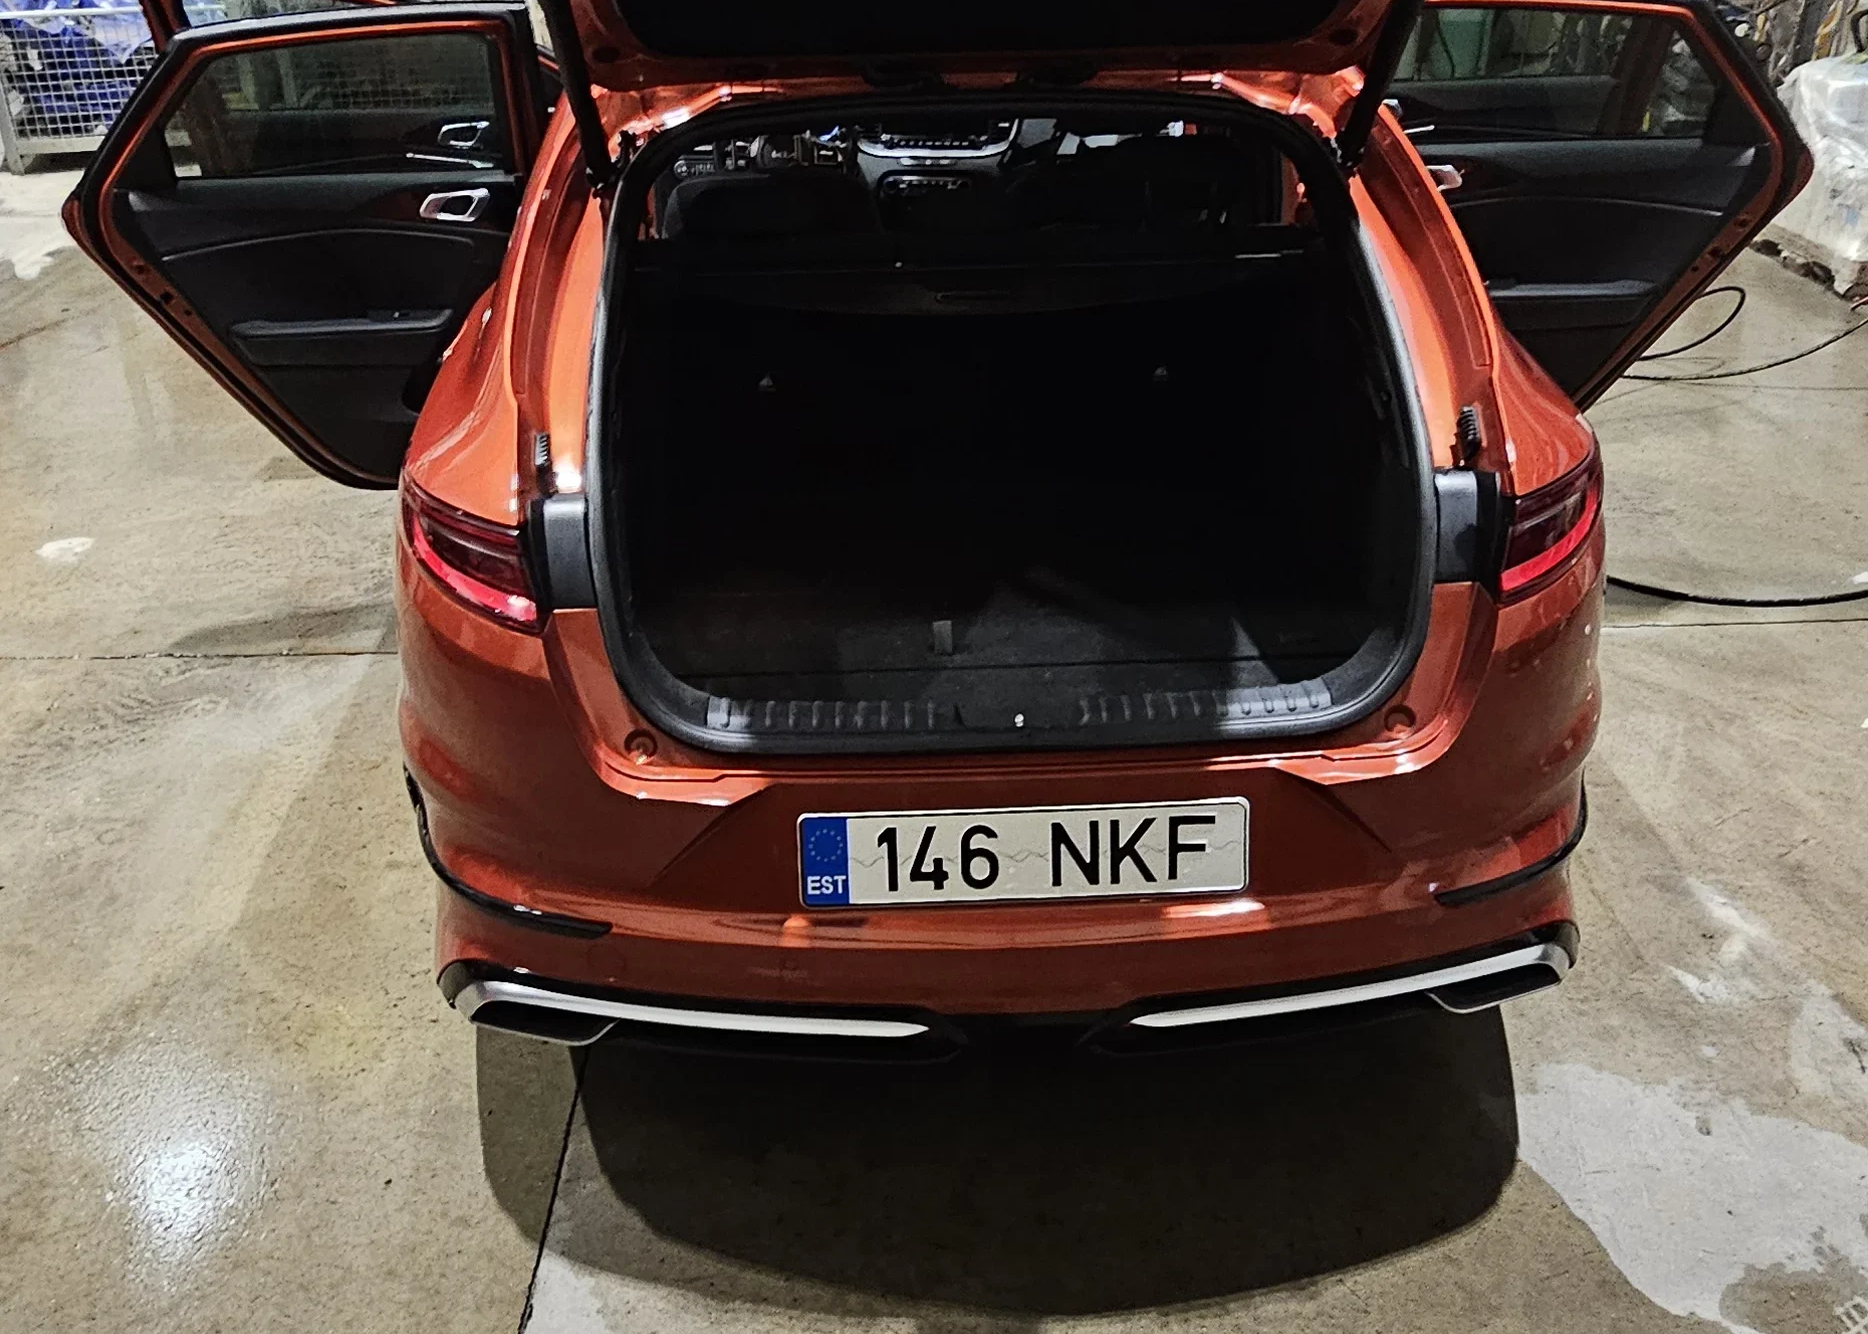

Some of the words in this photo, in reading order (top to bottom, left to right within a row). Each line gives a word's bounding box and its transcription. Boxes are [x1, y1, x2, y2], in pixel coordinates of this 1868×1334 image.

[877, 825, 999, 892] 146
[1051, 815, 1216, 887] NKF
[807, 875, 846, 895] EST
